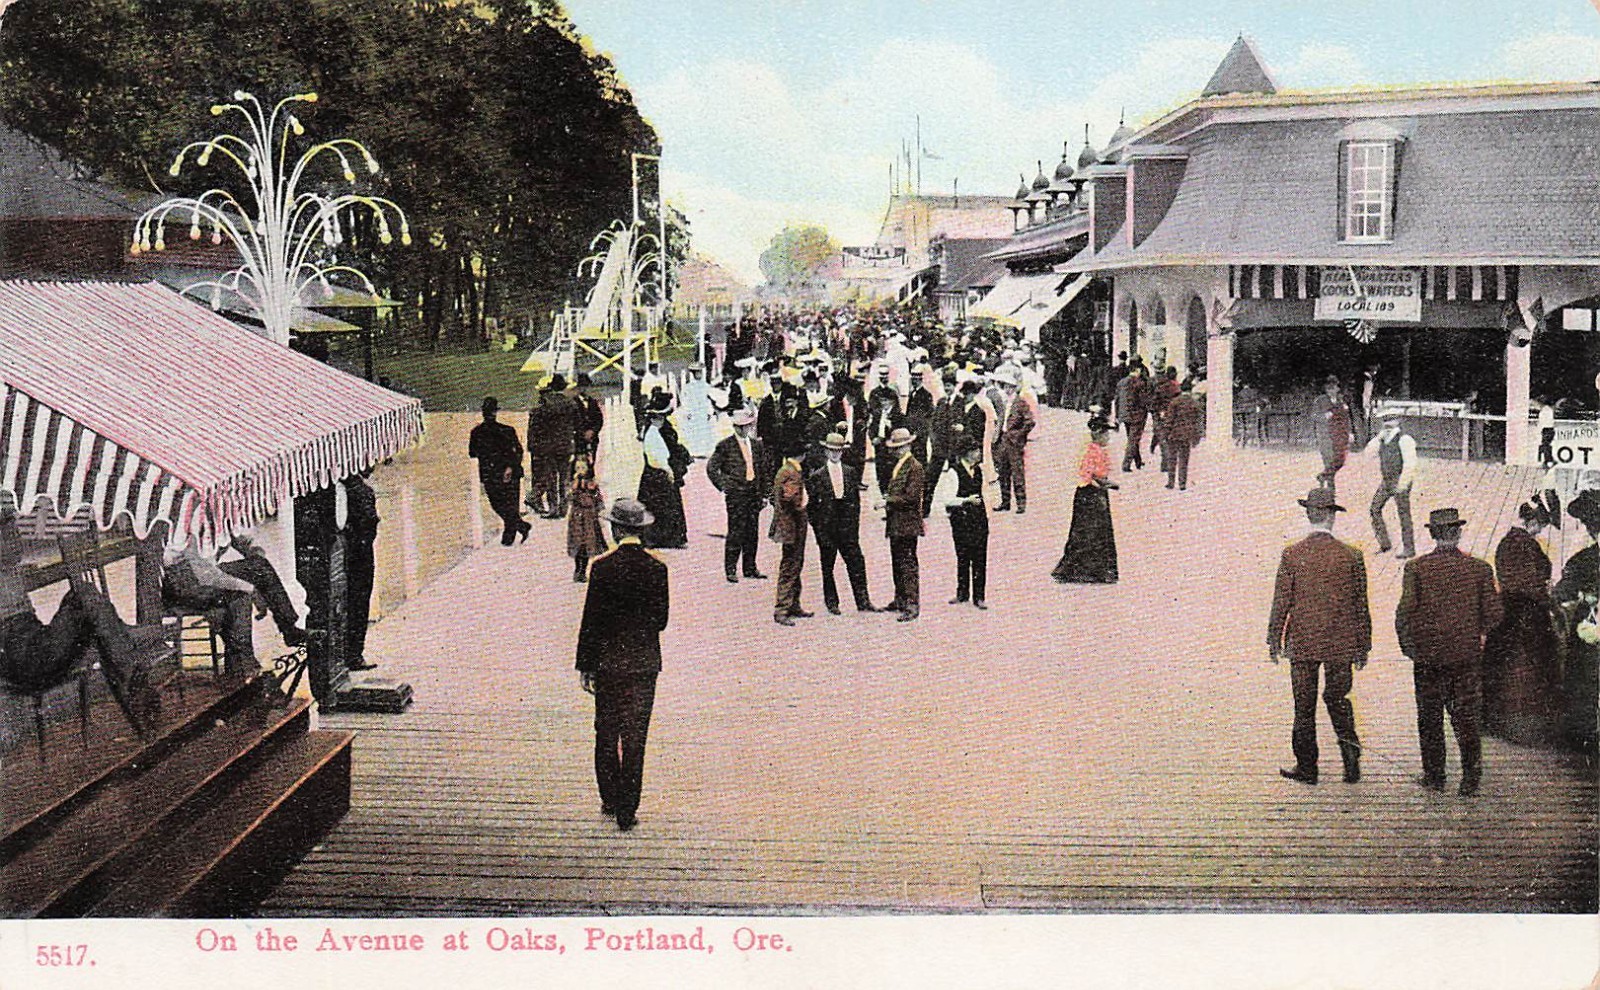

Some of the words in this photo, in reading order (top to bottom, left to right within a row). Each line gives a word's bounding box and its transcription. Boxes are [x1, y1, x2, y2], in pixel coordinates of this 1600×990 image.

[1321, 285, 1356, 297] COOKS
[1367, 285, 1413, 297] WAITERS
[1337, 302, 1371, 311] LOCAL
[1557, 446, 1593, 465] OT
